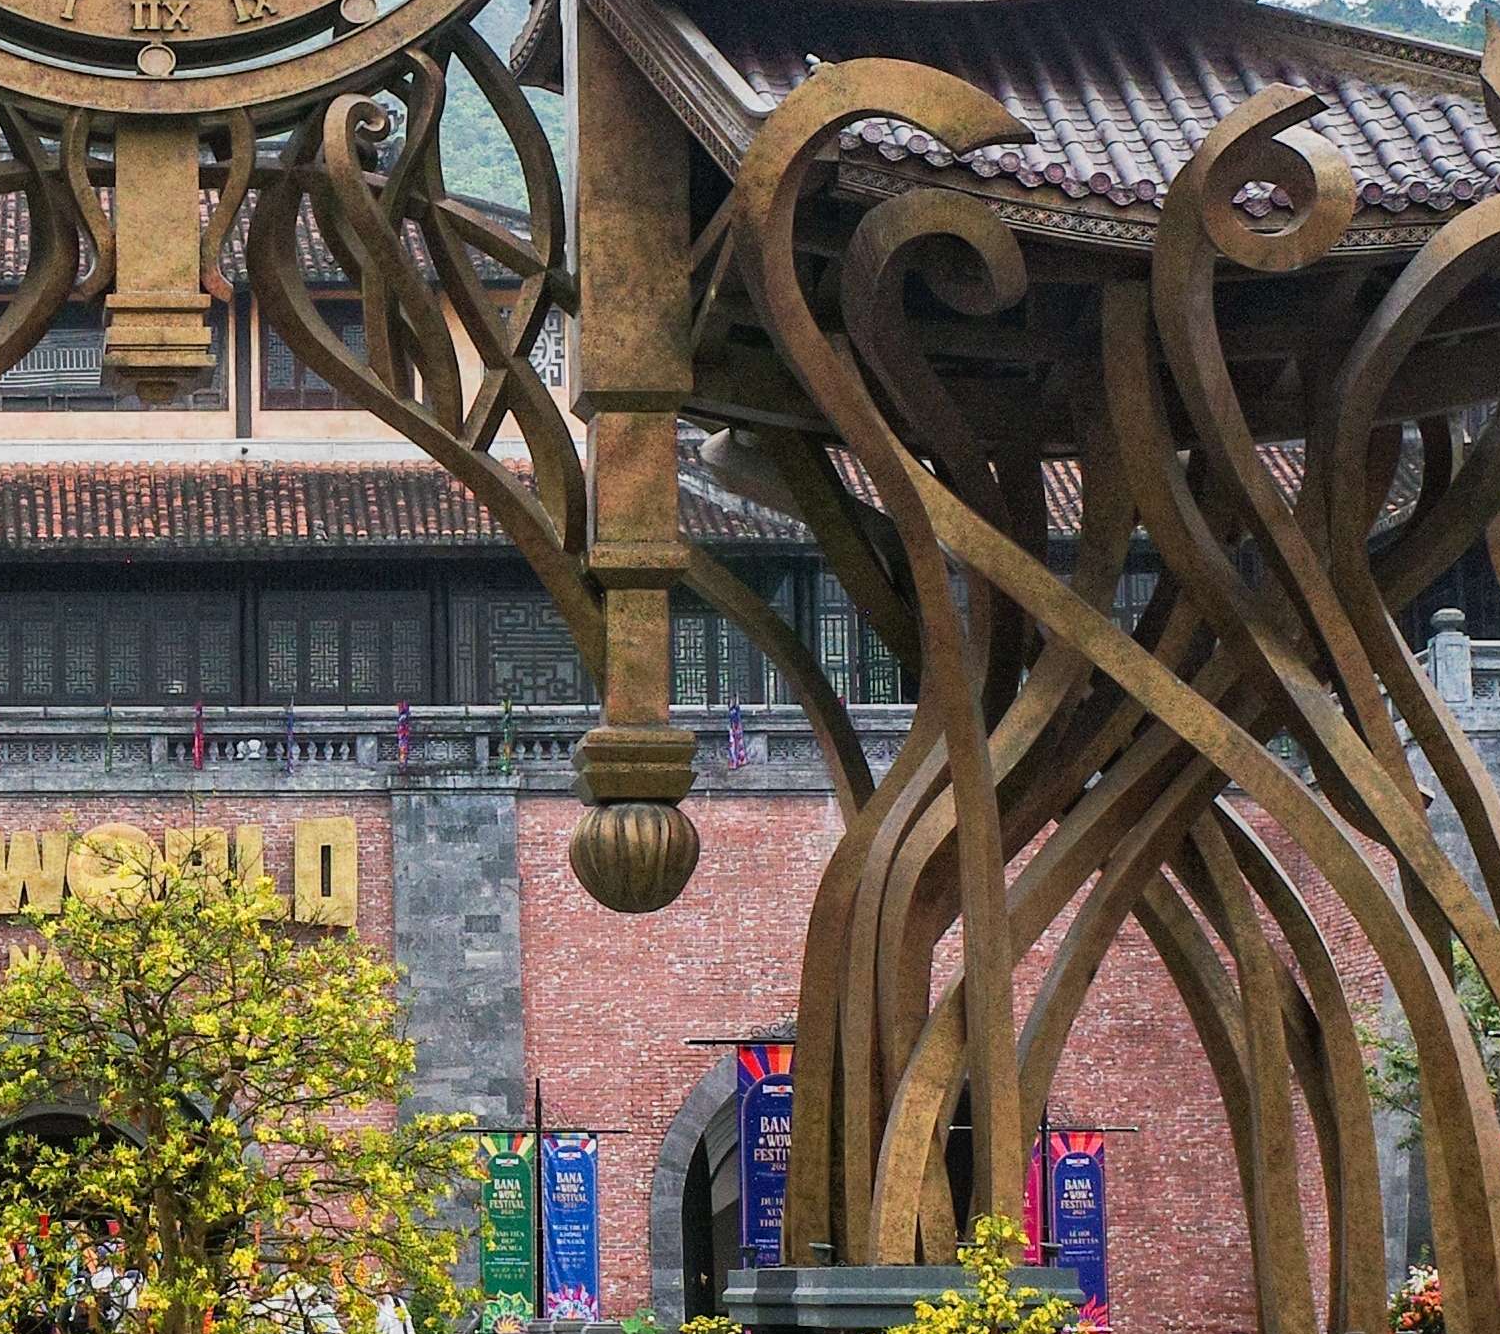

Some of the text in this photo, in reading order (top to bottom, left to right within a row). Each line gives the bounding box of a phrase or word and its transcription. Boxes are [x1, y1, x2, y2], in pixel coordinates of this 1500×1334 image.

[131, 0, 192, 31] XII
[760, 1116, 791, 1133] BAN
[754, 1149, 790, 1161] FESTI
[771, 1163, 787, 1171] 202
[556, 1172, 583, 1183] BANA
[494, 1179, 521, 1190] BANA
[560, 1184, 580, 1192] WOW
[1064, 1179, 1092, 1190] BANA
[498, 1191, 518, 1199] WOW
[552, 1193, 588, 1202] FESTIVAL
[1069, 1191, 1088, 1199] WOW
[489, 1200, 526, 1209] FESTIVAL
[1061, 1200, 1096, 1209] FESTIVAL
